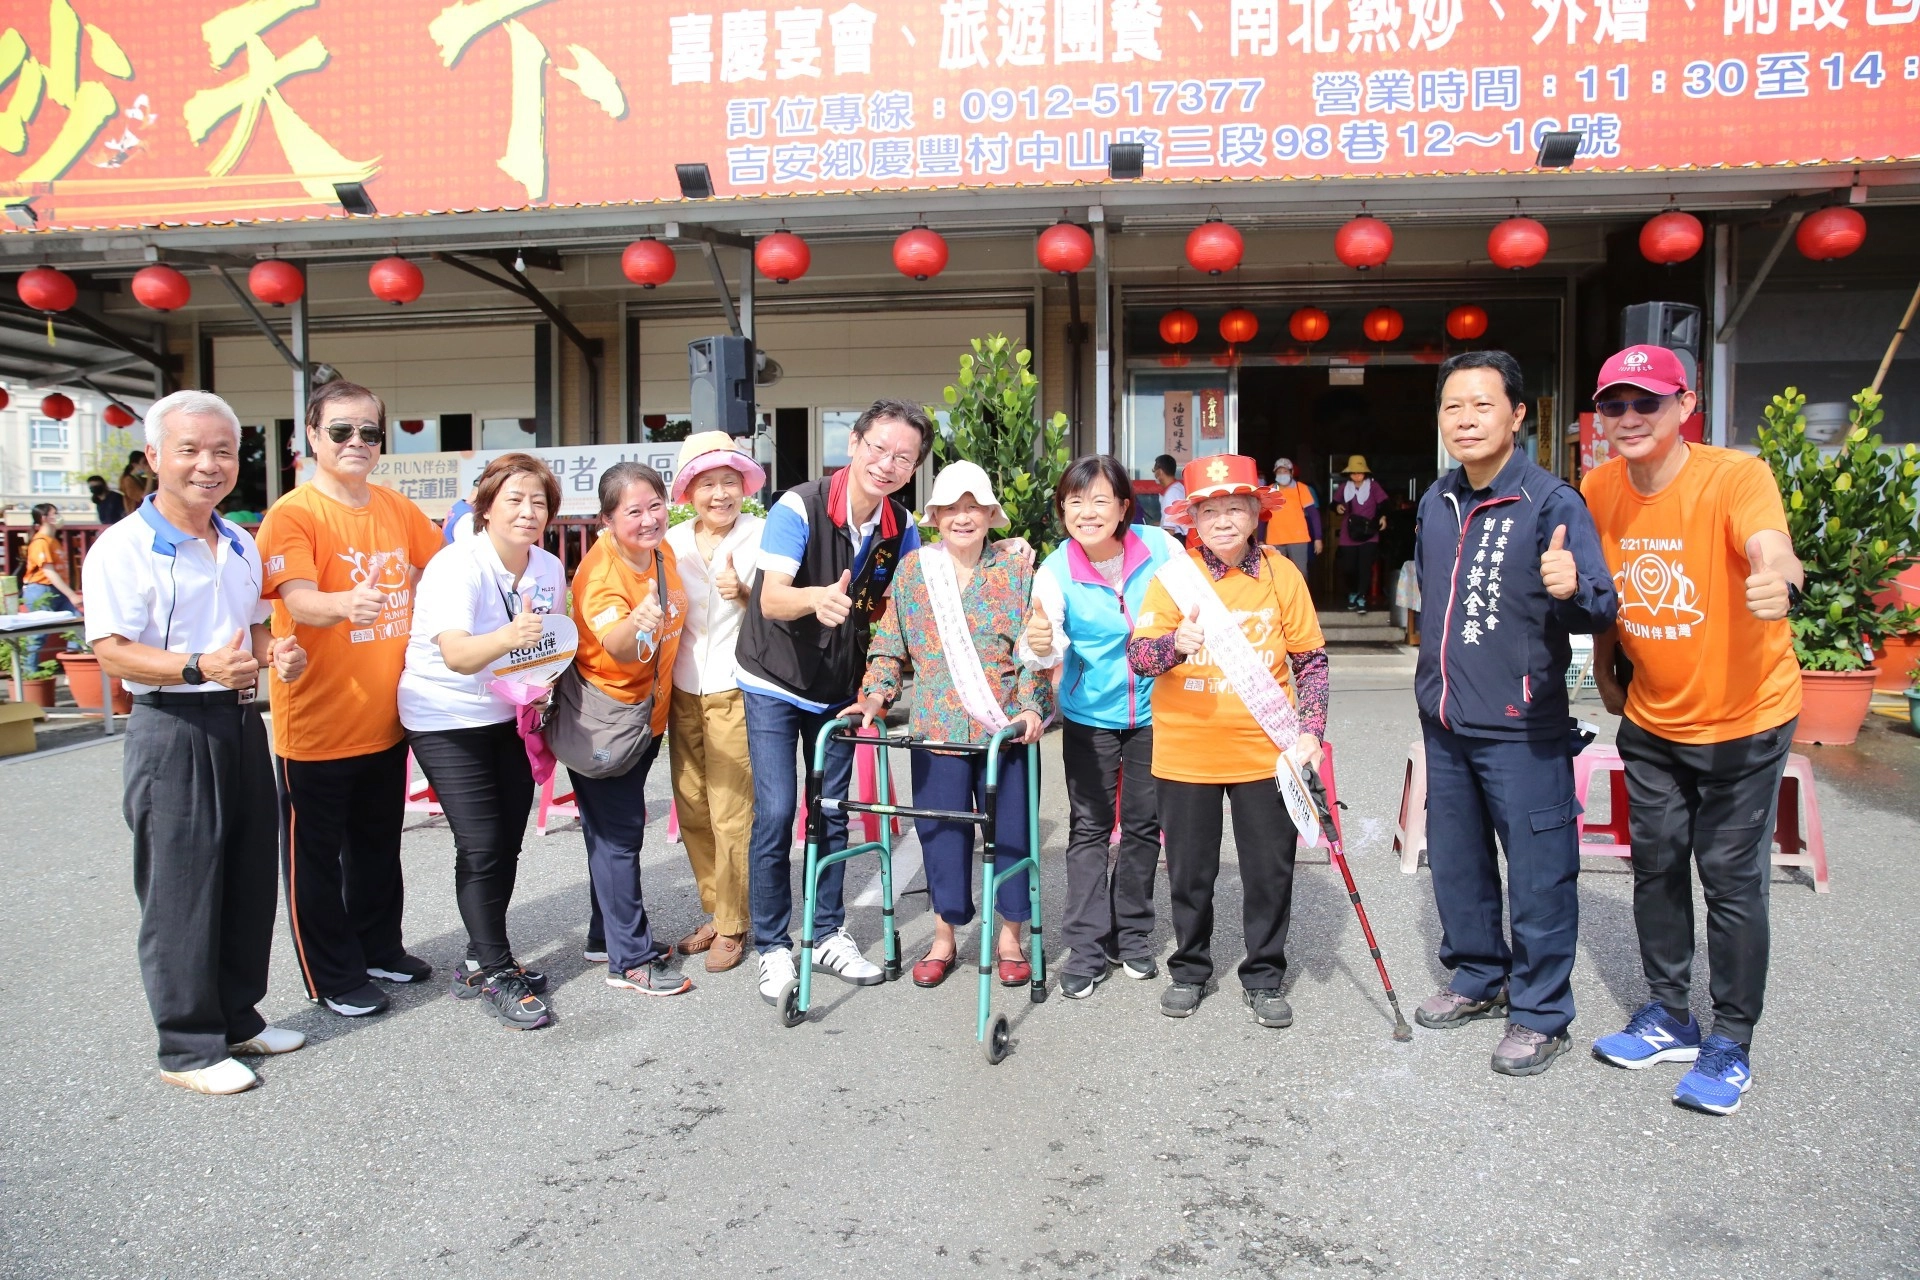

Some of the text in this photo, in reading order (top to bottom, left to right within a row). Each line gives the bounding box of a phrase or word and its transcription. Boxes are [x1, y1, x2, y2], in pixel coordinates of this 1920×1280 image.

[399, 478, 457, 499] 花蓮場
[1485, 517, 1514, 631] 吉安鄉民代表會
[1642, 538, 1683, 551] TAIWAN
[1461, 517, 1496, 645] 副主席 黃金發
